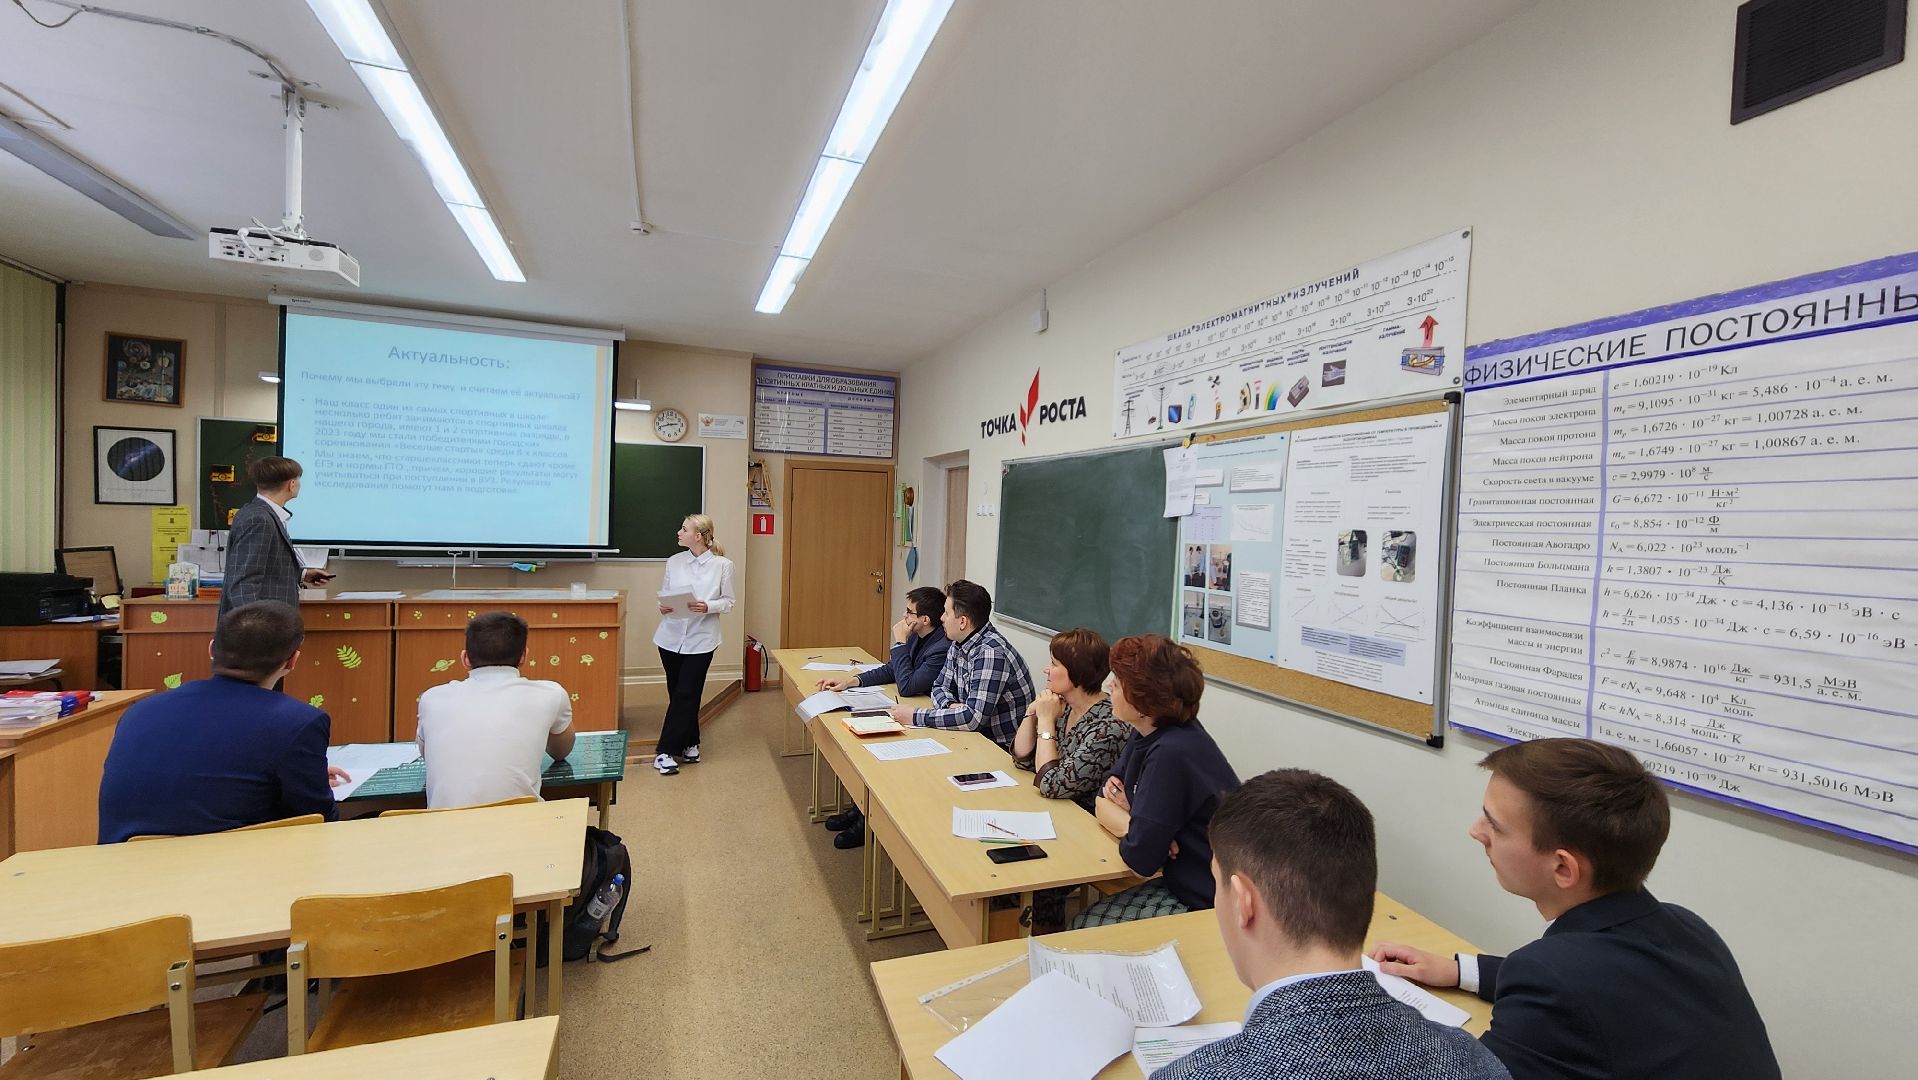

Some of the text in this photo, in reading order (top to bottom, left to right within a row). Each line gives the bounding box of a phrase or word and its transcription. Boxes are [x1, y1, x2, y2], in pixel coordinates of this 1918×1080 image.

[1167, 267, 1360, 342] ШКАЛА ЭЛЕКТРОМАГНИТНЫХ ИЗЛУЧЕНИЙ
[388, 345, 511, 369] Актуальность:
[1464, 334, 1647, 385] ФИЗИЧЕСКИЕ
[1720, 364, 1739, 377] Кл
[301, 370, 342, 383] Почему
[345, 376, 363, 384] мы
[365, 376, 411, 388] выбрали
[432, 382, 455, 392] тему
[468, 385, 508, 397] считаем
[524, 388, 581, 401] актуальной?
[777, 372, 877, 389] ПРИСТАВКИ ДЛЯ ОБРАЗОВАНИЯ
[801, 382, 830, 392] КРАТНЫХ
[837, 386, 869, 395] ДОЛЬНЫХ
[1503, 390, 1568, 406] Элементарный
[1752, 383, 1789, 398] 5,486
[315, 398, 339, 408] Наш
[341, 400, 370, 410] класс
[373, 401, 399, 412] один
[416, 405, 449, 416] самых
[449, 408, 507, 420] спортивных
[314, 409, 370, 420] несколько
[475, 419, 531, 431] спортивных
[314, 419, 354, 430] нашего
[357, 421, 397, 432] города,
[980, 396, 1087, 440] ТОЧКА РОСТА
[1492, 415, 1518, 428] Масса
[1550, 409, 1596, 422] электрона
[1642, 420, 1678, 434] 1,6726
[1757, 408, 1809, 424] 1,00728
[315, 427, 340, 437] 2023
[343, 429, 366, 441] году
[369, 431, 386, 440] мы
[388, 432, 417, 441] стали
[420, 434, 491, 446] победителями
[1499, 431, 1596, 448] Масса покоя протона
[533, 450, 569, 460] классов
[1639, 444, 1675, 458] 1,6749
[1754, 435, 1807, 450] 1,00867
[315, 450, 334, 458] Мы
[375, 453, 393, 461] что
[395, 455, 481, 467] старшеклассники
[484, 458, 516, 468] теперь
[517, 460, 546, 470] сдают
[315, 460, 334, 468] ЕГЭ
[346, 462, 383, 472] нормы
[385, 462, 404, 472] ГТО
[1492, 456, 1518, 467] Масса
[1549, 451, 1593, 463] нейтрона
[383, 472, 401, 482] при
[1482, 474, 1595, 488] Скорость света вакууме
[1630, 469, 1666, 482] 2,9979
[315, 481, 388, 490] исследования
[1468, 497, 1595, 508] Гравитационная постоянная
[1633, 493, 1663, 504] 6,672
[1472, 519, 1592, 529] Электрическая постоянная
[1632, 518, 1662, 530] 8,854
[1492, 539, 1591, 551] Постоянная Авогадро
[1636, 542, 1667, 553] 6,022
[1484, 558, 1590, 573] Постоянная Больцмана
[1627, 565, 1662, 577] 1,3807
[1496, 579, 1587, 596] Постоянная Планка
[1623, 588, 1873, 618] 6,626 Дж 4,136 эВ
[1465, 617, 1584, 642] Коэффициент взаимосвязи
[1650, 614, 1906, 649] 1,055 Дж 6,59 эВ
[1507, 637, 1583, 657] массы энергии
[1489, 656, 1583, 683] Постоянная Фарадея
[1651, 656, 1689, 671] 8,9874
[1773, 673, 1812, 691] 931,5
[1823, 675, 1858, 690] МэВ
[1454, 671, 1582, 707] Молярная газовая постоянная
[1655, 686, 1686, 701] 9,648
[1473, 697, 1581, 731] Атомная единица массы
[1655, 712, 1686, 729] 8,314
[1655, 738, 1698, 758] 1,66057
[1782, 768, 1848, 794] 931,5016
[1854, 785, 1895, 805] МэВ
[1719, 780, 1741, 795] Дж
